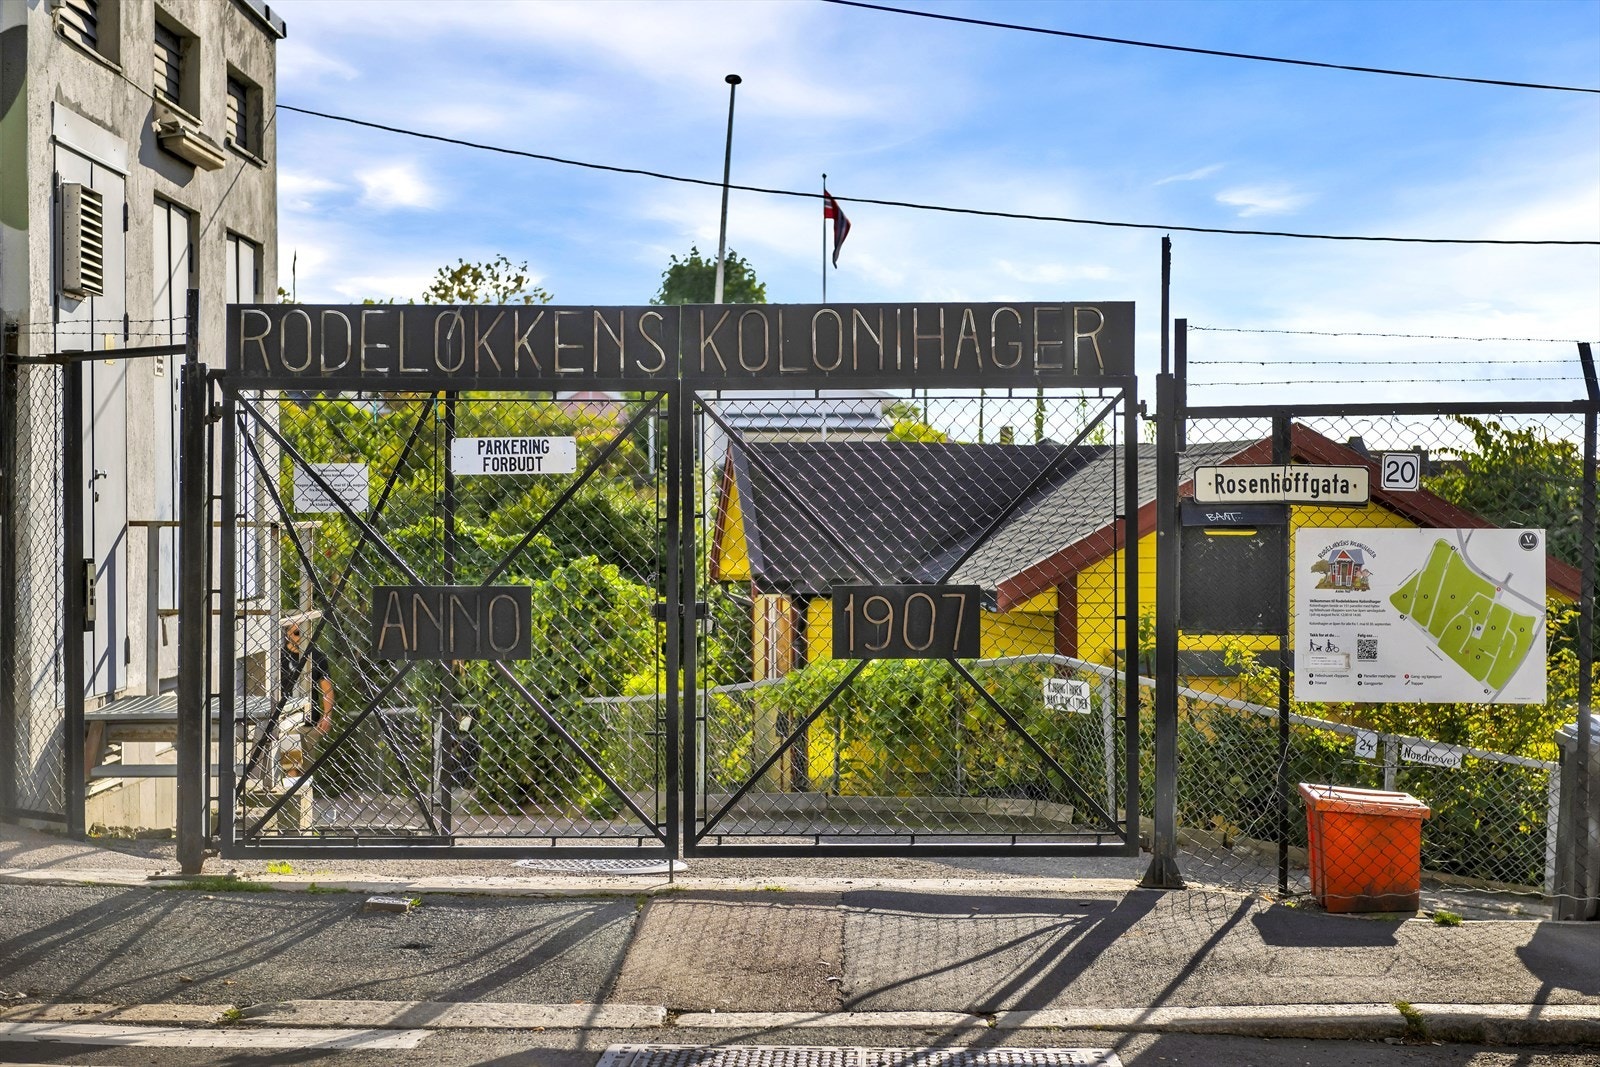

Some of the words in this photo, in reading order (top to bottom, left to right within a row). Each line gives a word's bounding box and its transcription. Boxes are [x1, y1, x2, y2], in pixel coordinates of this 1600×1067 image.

[240, 307, 667, 373] RODELØKKENS
[700, 306, 1106, 373] KOLONIHAGER
[477, 439, 550, 455] PARKERING
[483, 456, 543, 472] FORBUDT
[1385, 460, 1416, 483] 20
[1214, 472, 1350, 499] Rosenhoffgata
[377, 590, 521, 652] ANNO
[844, 592, 966, 652] 1907
[1359, 740, 1373, 750] 24
